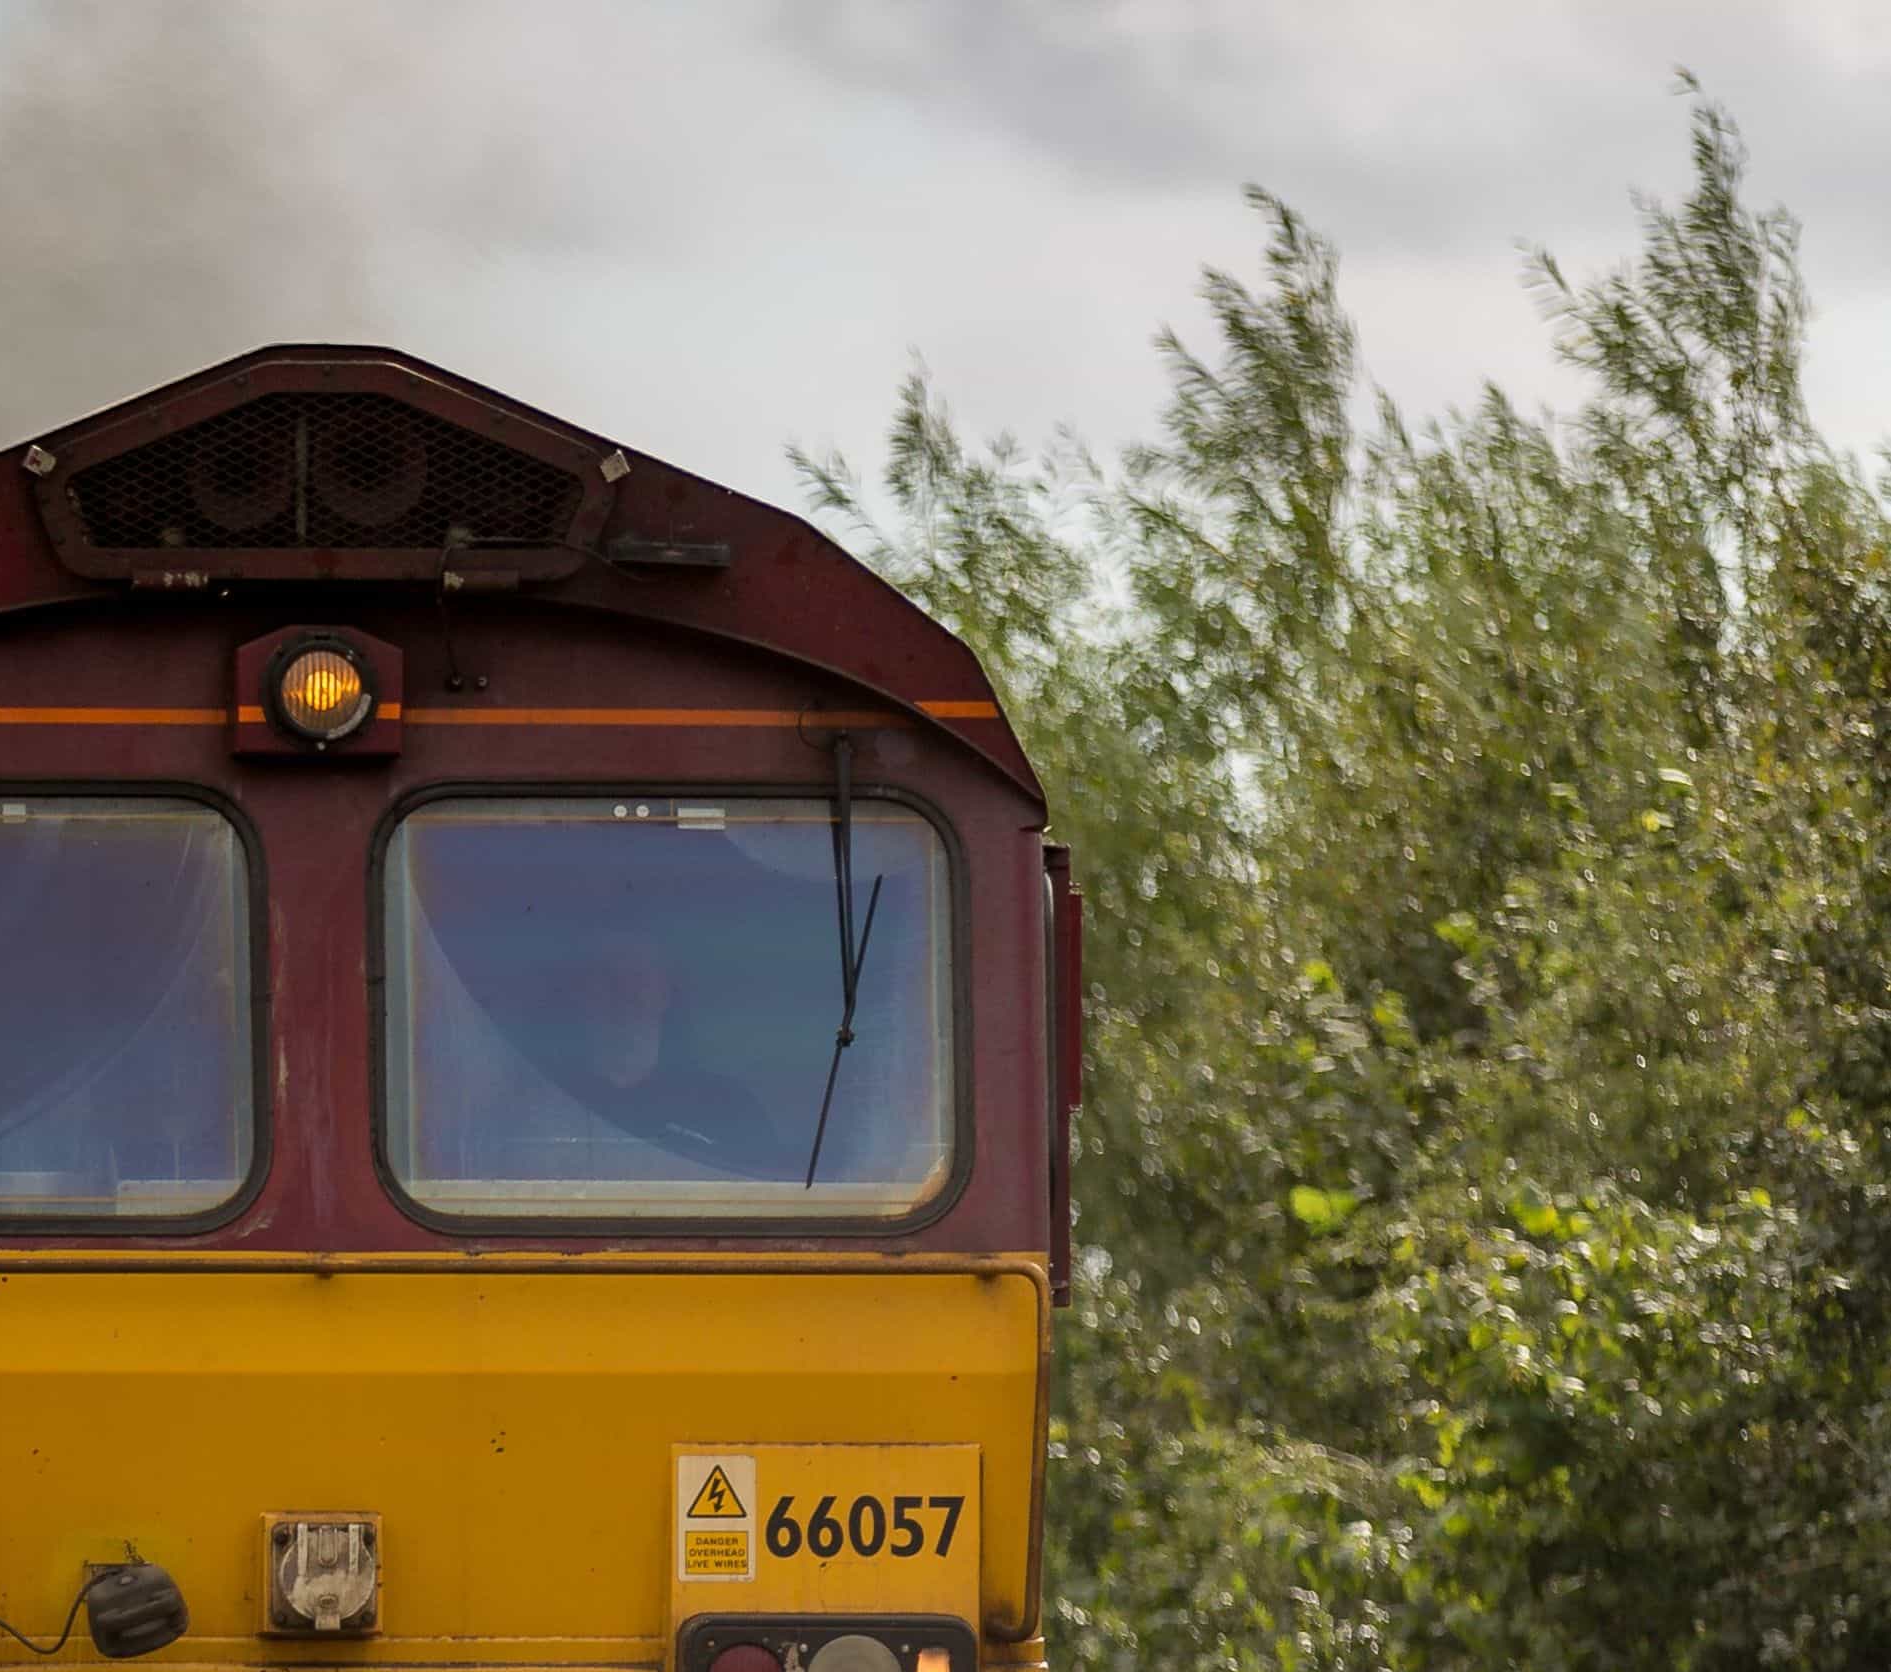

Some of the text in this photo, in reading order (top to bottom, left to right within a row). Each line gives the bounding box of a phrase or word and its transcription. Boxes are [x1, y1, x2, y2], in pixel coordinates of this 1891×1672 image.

[765, 1495, 966, 1559] 66057
[695, 1537, 739, 1546] DANGER
[689, 1548, 746, 1557] OVERHEAD
[687, 1559, 747, 1569] LIVE WIRES
